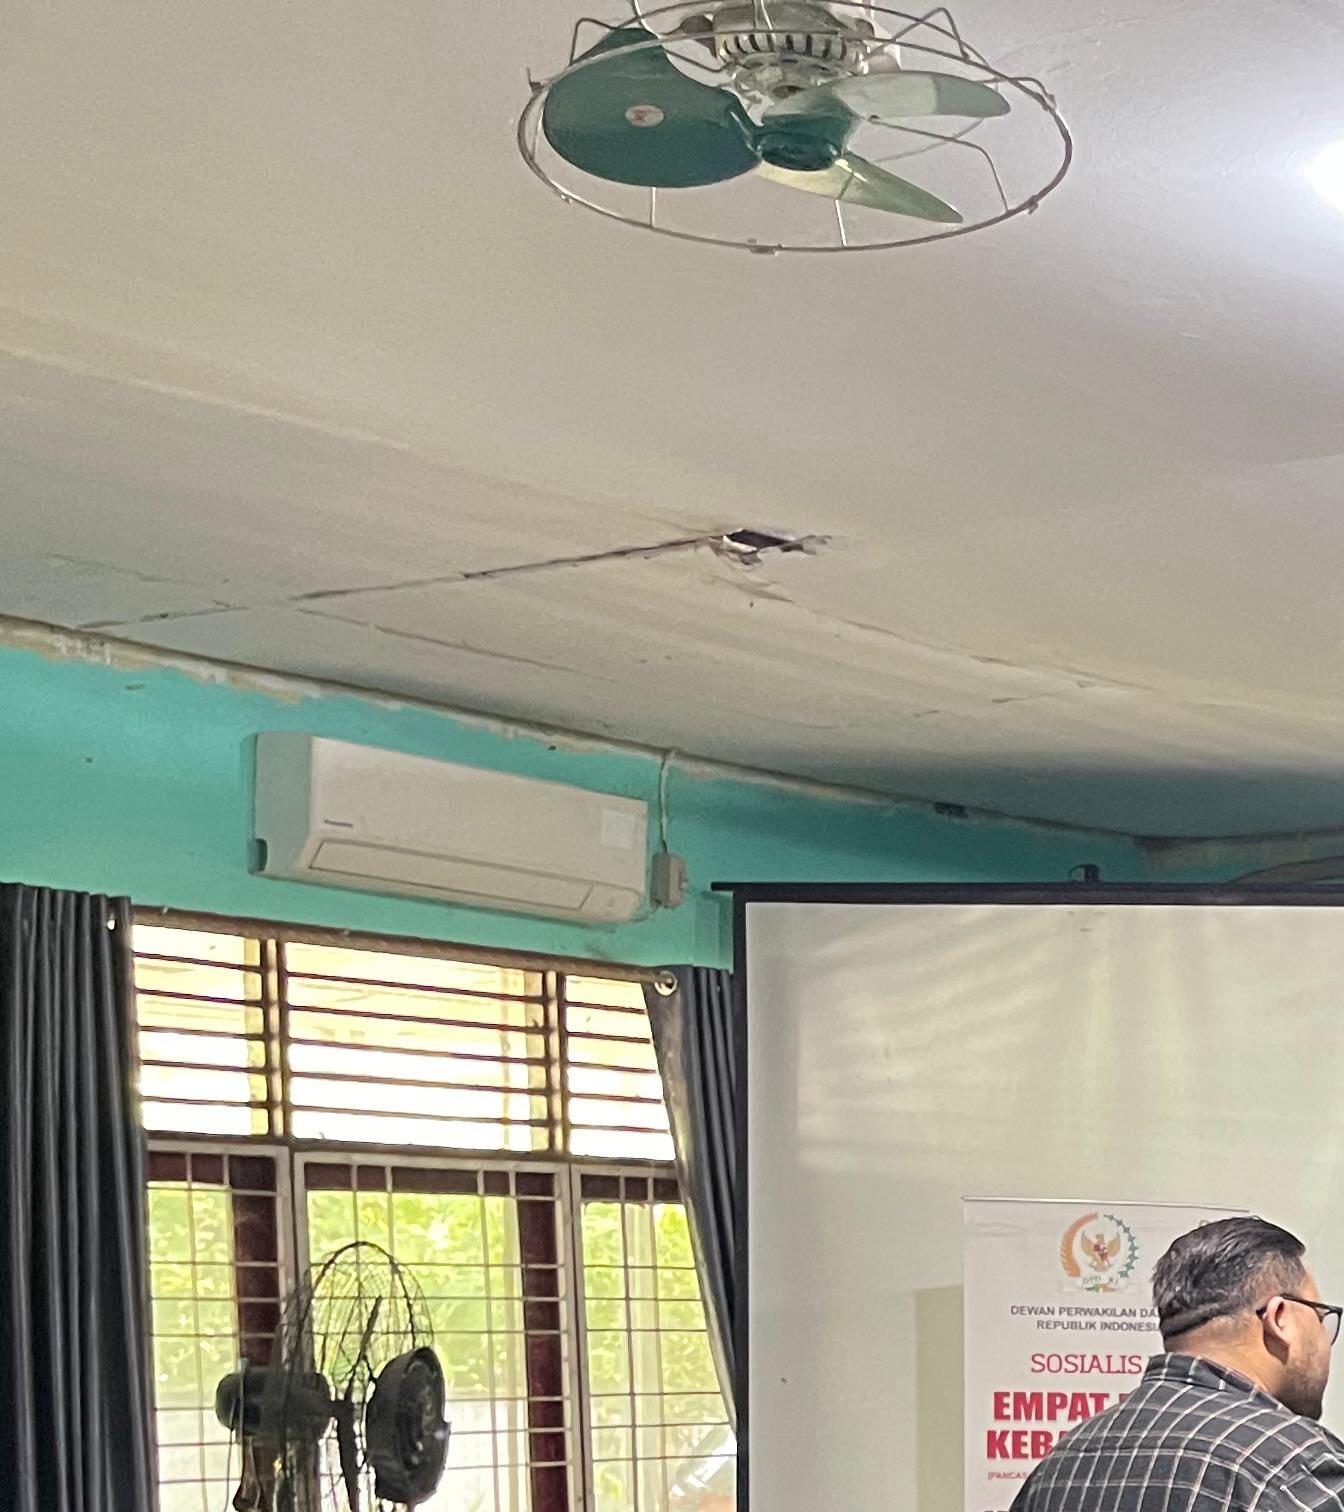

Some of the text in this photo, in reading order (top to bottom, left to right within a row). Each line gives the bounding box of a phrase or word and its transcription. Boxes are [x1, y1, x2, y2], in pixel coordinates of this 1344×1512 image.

[1010, 1305, 1055, 1317] DEWAN
[1058, 1306, 1137, 1318] PERWAKILAN
[1036, 1320, 1160, 1332] REPUBLIK INDONESI
[1030, 1353, 1143, 1375] SOSIALIS
[993, 1391, 1110, 1422] EMPAT
